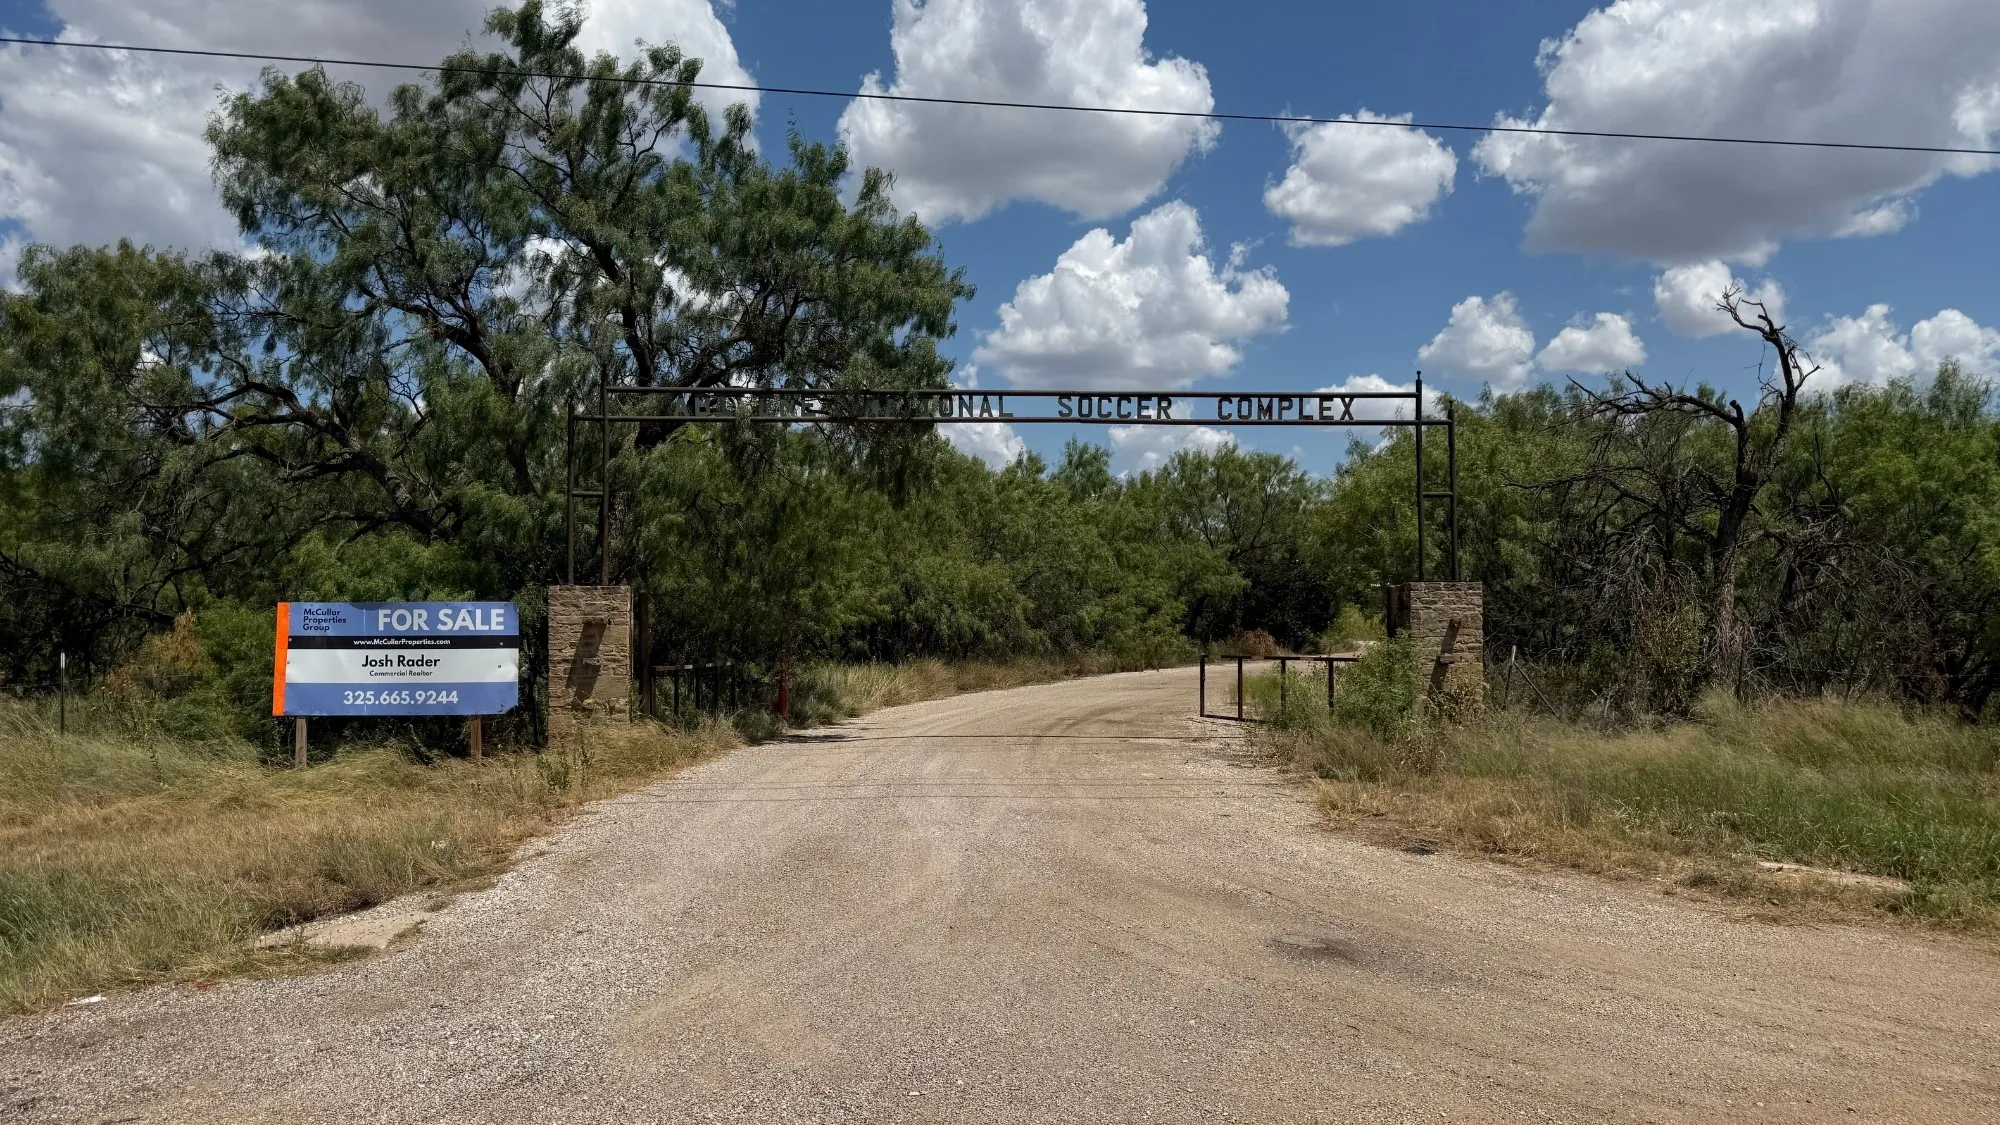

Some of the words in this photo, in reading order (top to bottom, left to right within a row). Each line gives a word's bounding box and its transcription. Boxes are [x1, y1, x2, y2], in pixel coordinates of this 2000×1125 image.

[1058, 395, 1172, 419] SOCCER
[1218, 396, 1354, 420] COMPLEX
[303, 608, 341, 616] McCullar
[303, 616, 347, 624] Properties
[378, 608, 430, 631] FOR
[437, 608, 505, 631] SALE
[302, 623, 331, 632] Group
[353, 638, 451, 647] www.McCullarProperties.com
[361, 654, 393, 668] Josh
[397, 654, 441, 668] Rader
[343, 690, 459, 704] 325.665.9244
